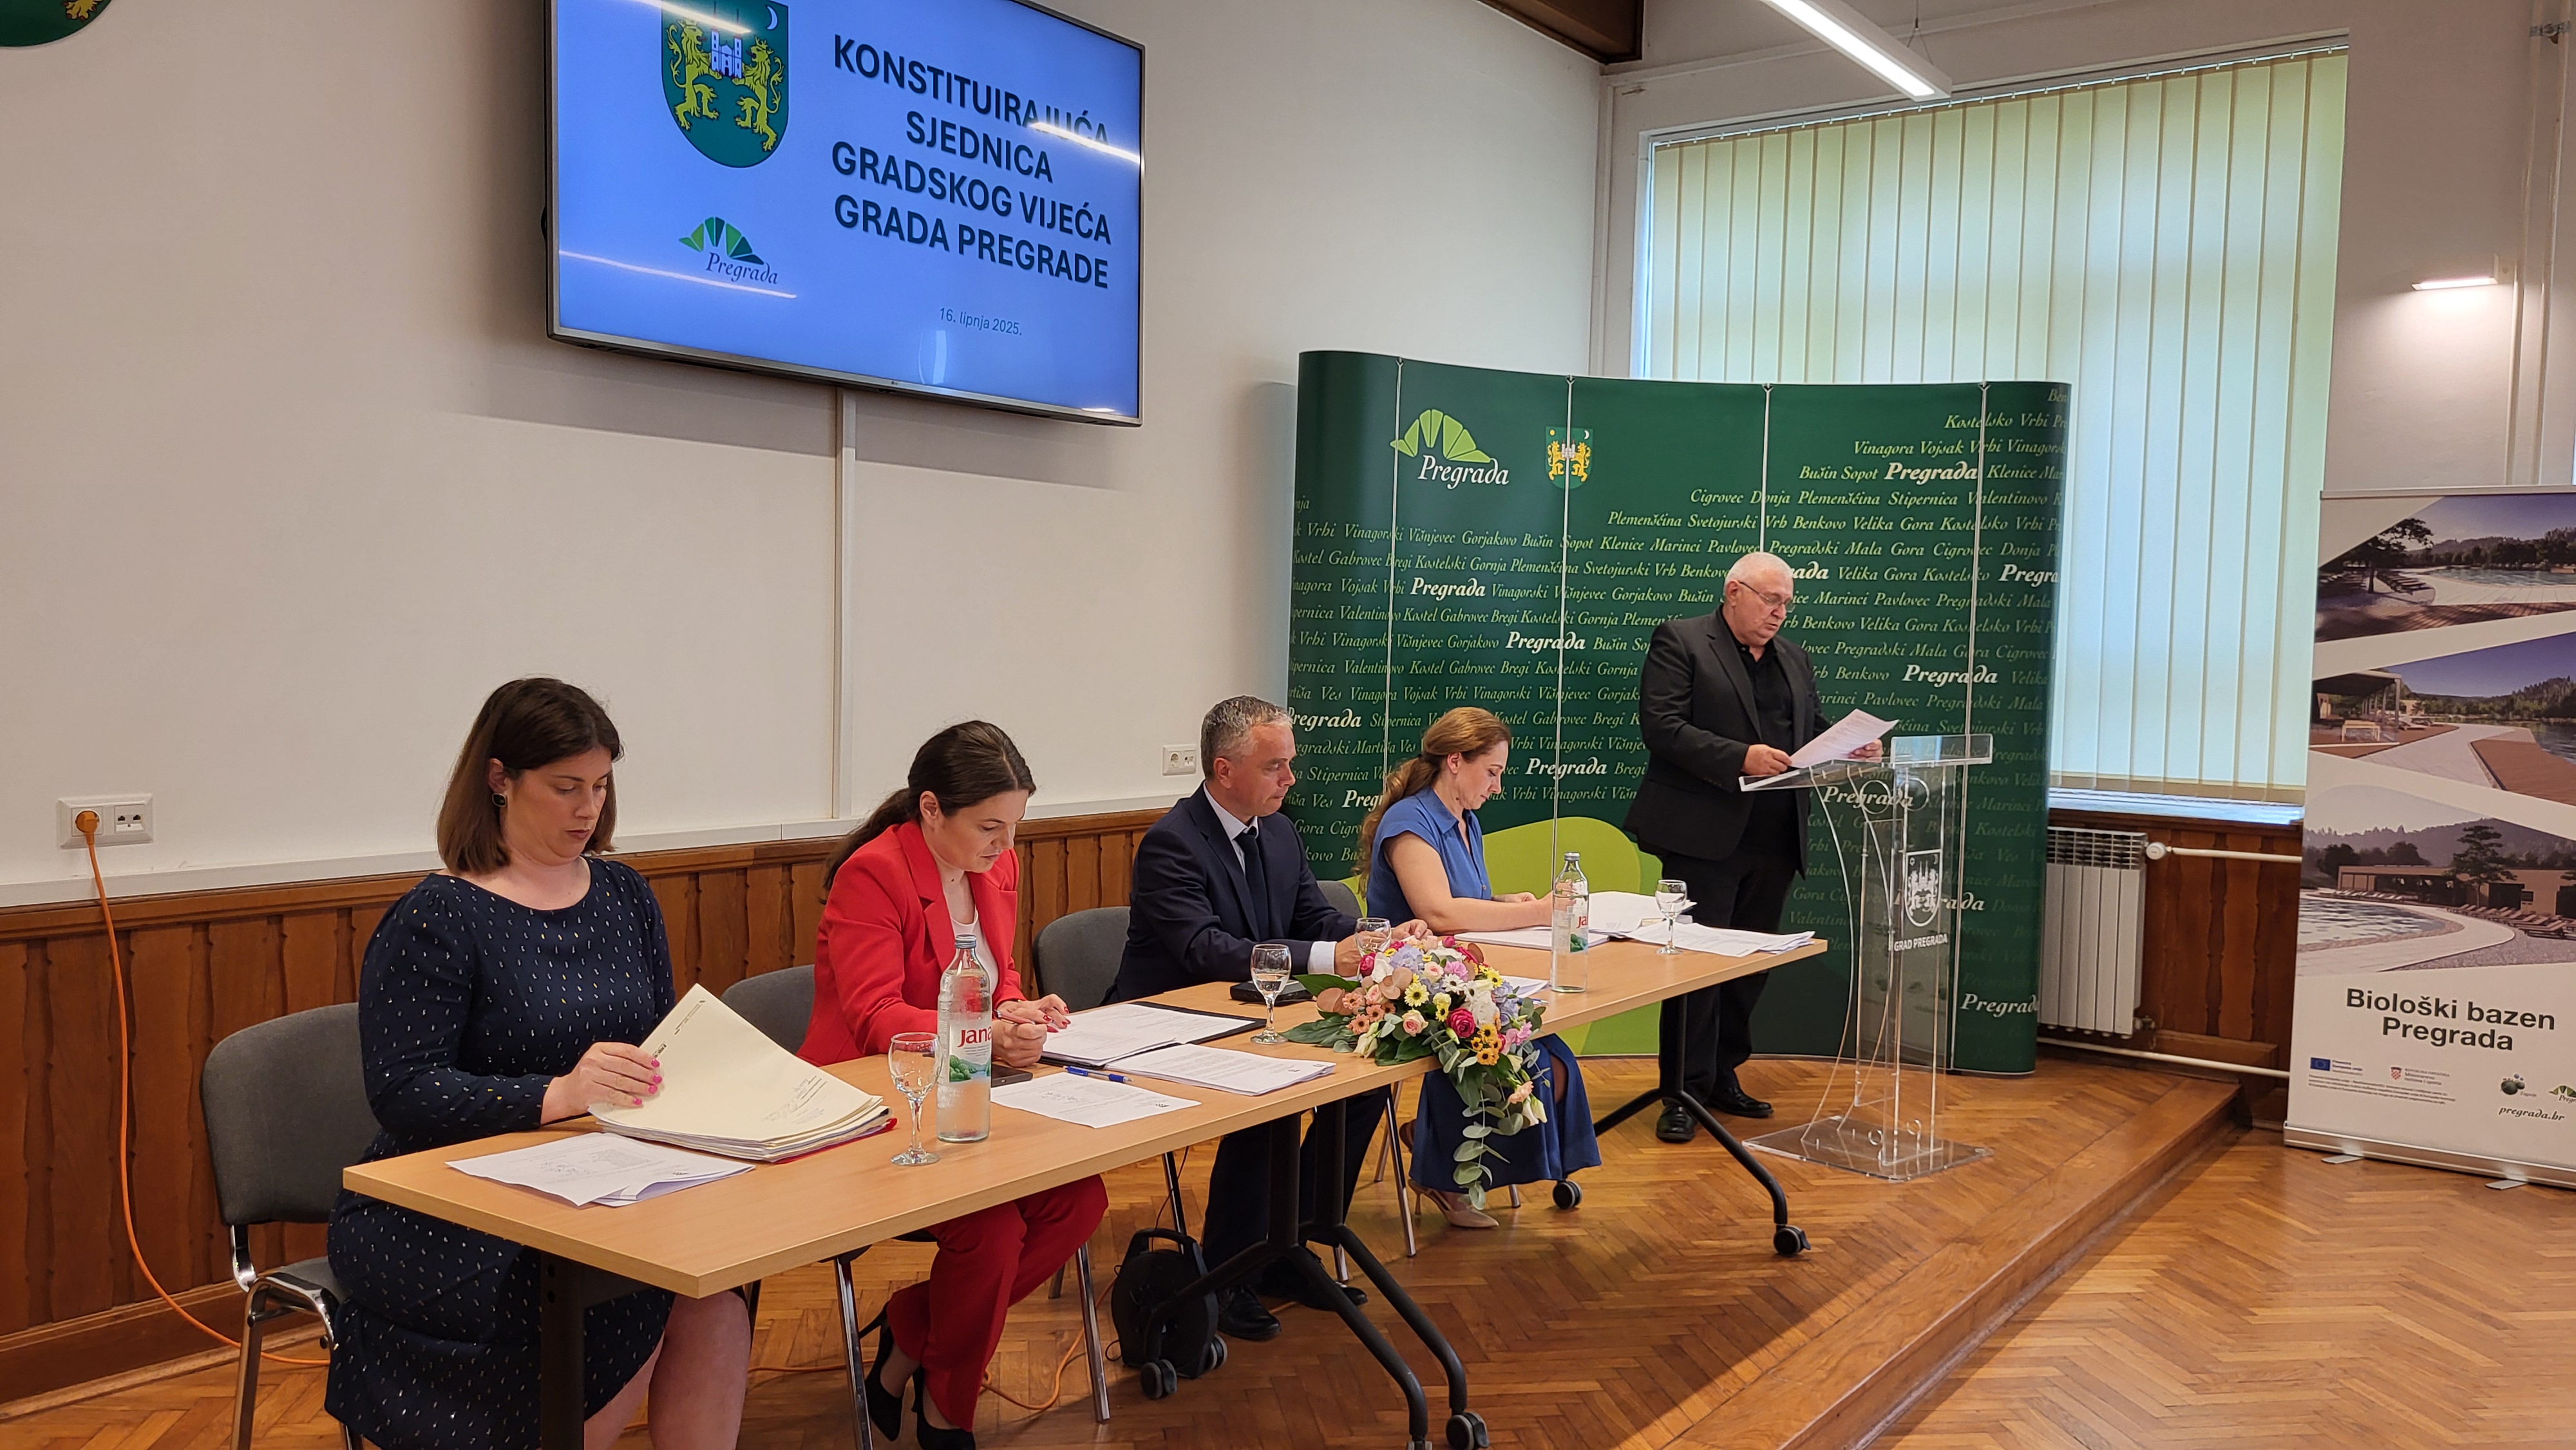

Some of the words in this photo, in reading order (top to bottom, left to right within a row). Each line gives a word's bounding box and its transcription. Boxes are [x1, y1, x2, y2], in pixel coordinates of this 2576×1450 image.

[835, 34, 1110, 145] KONSTITUIRAJUĆA
[905, 111, 1052, 183] SJEDNICA
[831, 142, 1012, 216] GRADSKOG
[1019, 191, 1111, 245] VIJEĆA
[834, 194, 949, 252] GRADA
[959, 225, 1108, 290] PREGRADE
[706, 252, 779, 285] Pregrada
[940, 308, 956, 325] 16.
[960, 312, 989, 332] lipnja
[992, 316, 1023, 337] 2025.
[1853, 440, 1914, 458] Vinagora
[1920, 440, 1964, 458] Vojsak
[1418, 455, 1510, 489] Pregrada
[1799, 465, 1837, 480] Bušin
[1841, 466, 1879, 484] Sopot
[1884, 460, 1978, 485] Pregrada
[1987, 464, 2037, 479] Klenice
[1690, 489, 1744, 506] Cigrovec
[1888, 491, 1958, 508] Stipernica
[1793, 516, 1846, 529] Benkovo
[1853, 515, 1894, 531] Velika
[1900, 517, 1934, 531] Gora
[1461, 530, 1517, 548] Gorjakovo
[1522, 533, 1553, 547] Bušin
[1600, 536, 1644, 551] Klenice
[1649, 536, 1702, 553] Marinci
[1769, 540, 1841, 558] Pregradski
[1844, 541, 1882, 555] Mala
[1891, 542, 1924, 556] Gora
[2000, 542, 2040, 560] Donja
[1329, 550, 1382, 566] Gabrovec
[1470, 557, 1507, 575] Gornja
[1839, 566, 1878, 579] Velika
[1884, 567, 1917, 581] Gora
[1341, 578, 1378, 596] Vojsak
[1410, 578, 1486, 601] Pregrada
[1492, 584, 1549, 601] Vinagorski
[1612, 587, 1672, 604] Gorjakovo
[1678, 588, 1714, 603] Bušin
[1814, 591, 1870, 605] Marinci
[1873, 592, 1931, 607] Pavlovec
[2016, 594, 2051, 608] Mala
[1403, 607, 1438, 621] Kostel
[1441, 608, 1489, 622] Gabrovec
[1491, 610, 1519, 626] Bregi
[1578, 611, 1619, 630] Gornja
[1802, 615, 1855, 630] Benkovo
[1861, 617, 1900, 631] Velika
[1904, 617, 1937, 632] Gora
[1942, 618, 2010, 632] Koselsko
[1447, 634, 1499, 652] Gorjakovo
[1506, 632, 1586, 654] Pregrada
[1593, 637, 1627, 650] Bušin
[1835, 641, 1908, 659] Pregradski
[1909, 643, 1947, 657] Mala
[1409, 660, 1444, 675] Kostel
[1449, 659, 1495, 675] Gabrovec
[1501, 661, 1531, 677] Bregi
[1597, 662, 1638, 678] Gornja
[1835, 666, 1889, 680] Benkovo
[1902, 664, 1998, 687] Pregrada
[1404, 686, 1437, 704] Vojsak
[1473, 686, 1532, 702] Vinagorski
[1863, 692, 1919, 706] Pavlovec
[1926, 693, 2002, 711] Pregrdski
[1593, 712, 1625, 728] Bregi
[1307, 766, 1369, 784] Stipernica
[1525, 757, 1607, 779] Pregrada
[1614, 762, 1647, 778] Bregi
[1894, 939, 1912, 952] GRAD
[1913, 933, 1947, 949] PREGRADA
[2346, 988, 2457, 1019] Biološki
[2468, 1001, 2555, 1030] bazen
[2383, 1017, 2512, 1050] Pregrada
